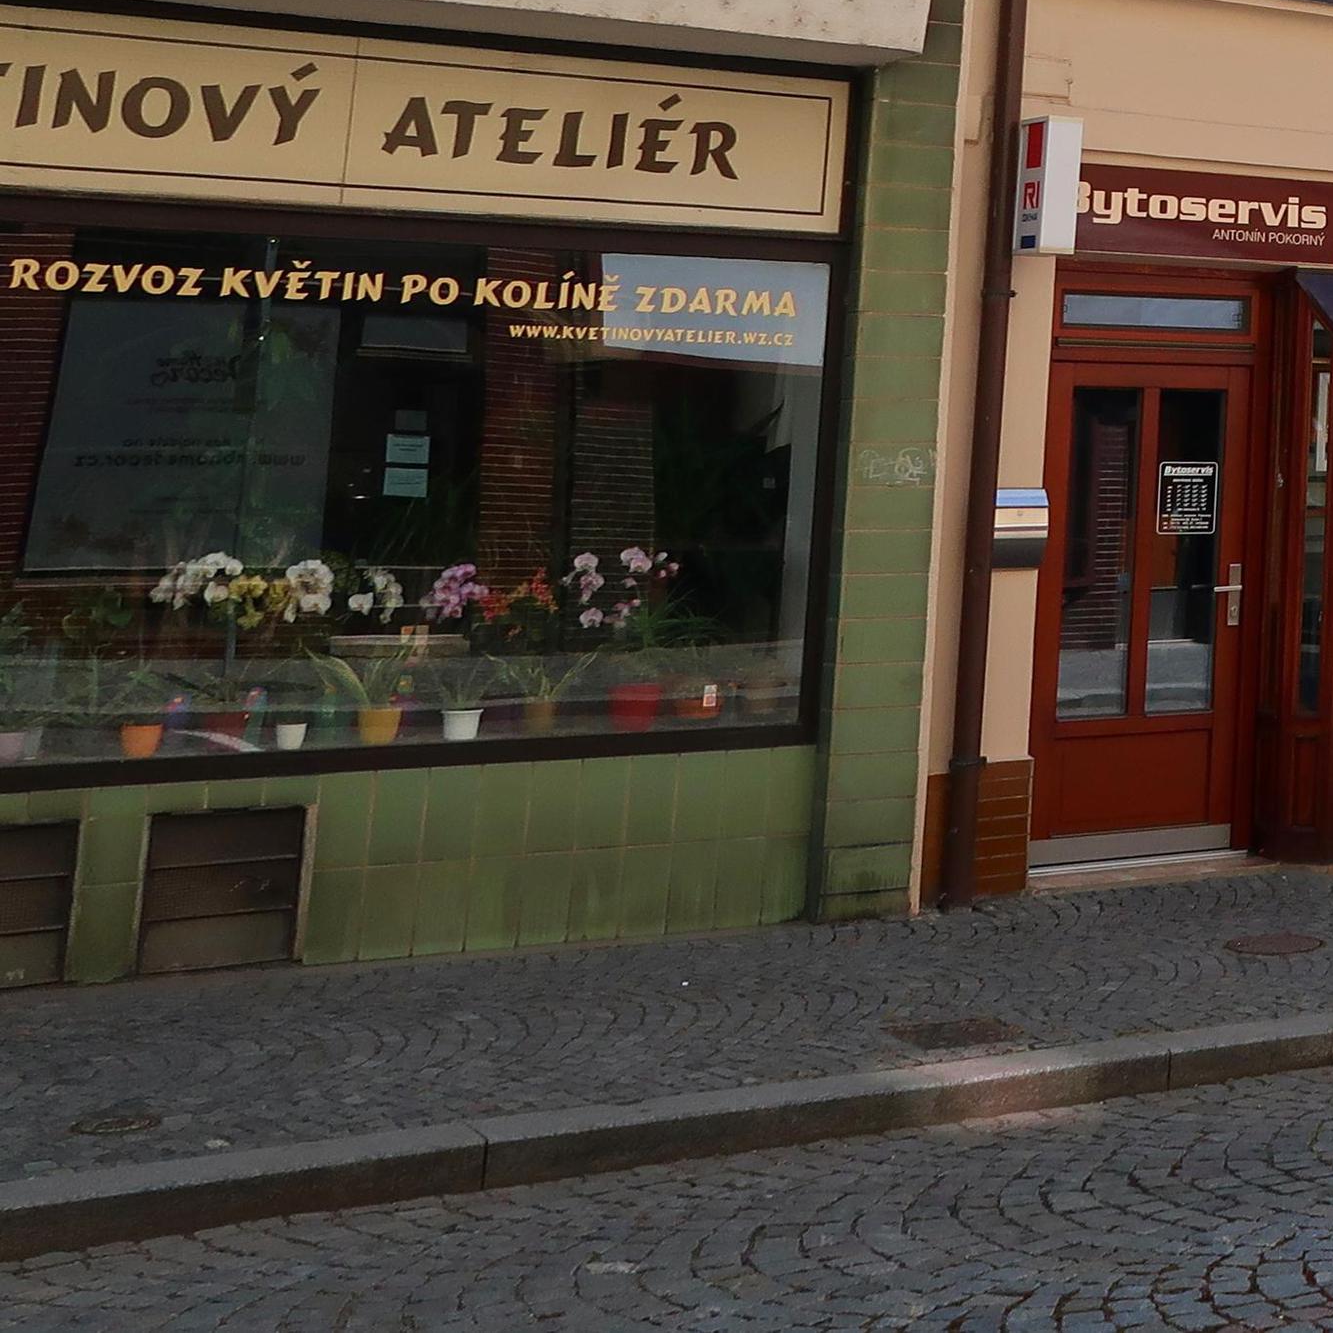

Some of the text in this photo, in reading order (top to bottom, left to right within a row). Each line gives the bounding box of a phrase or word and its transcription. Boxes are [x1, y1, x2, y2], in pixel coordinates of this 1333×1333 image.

[381, 93, 740, 180] ATELIÉR
[1212, 228, 1326, 247] ANTONÍN POKORNÝ
[9, 258, 797, 319] ROZVOZ KVĚTIN PO KOLÍNĚ ZDARMA
[509, 323, 794, 348] WWW.KVETINOVYATELIER.WZ.CZ
[1164, 465, 1213, 475] Bytoservis
